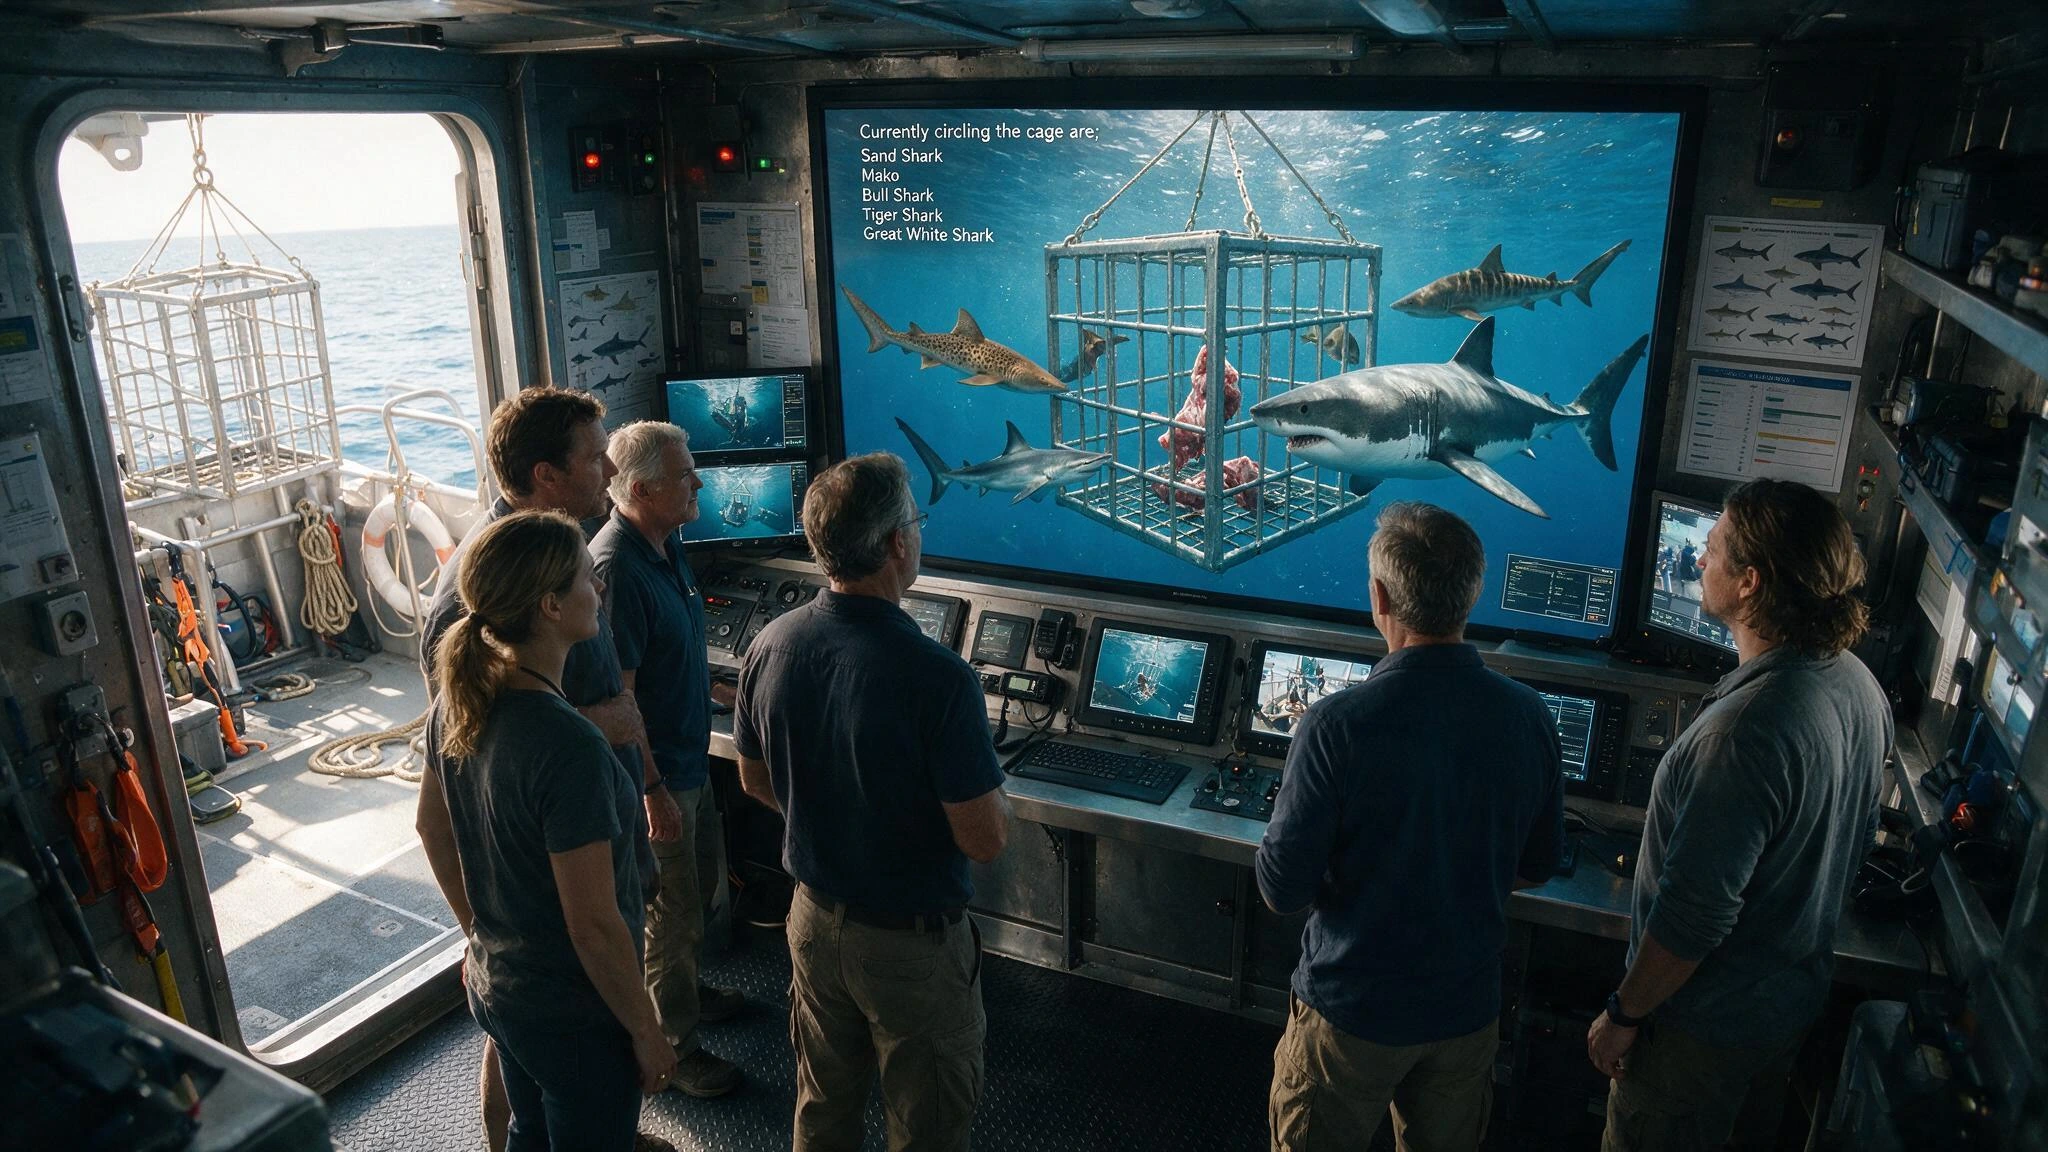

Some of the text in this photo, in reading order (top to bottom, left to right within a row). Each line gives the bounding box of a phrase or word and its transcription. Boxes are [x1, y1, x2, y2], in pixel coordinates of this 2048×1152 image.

[859, 122, 1100, 143] Currently circling the cage are;
[861, 148, 944, 163] Sand Shark
[862, 168, 900, 183] Mako
[862, 187, 934, 203] Bull Shark
[862, 207, 943, 225] Tiger Shark
[863, 226, 995, 243] Great White Shark
